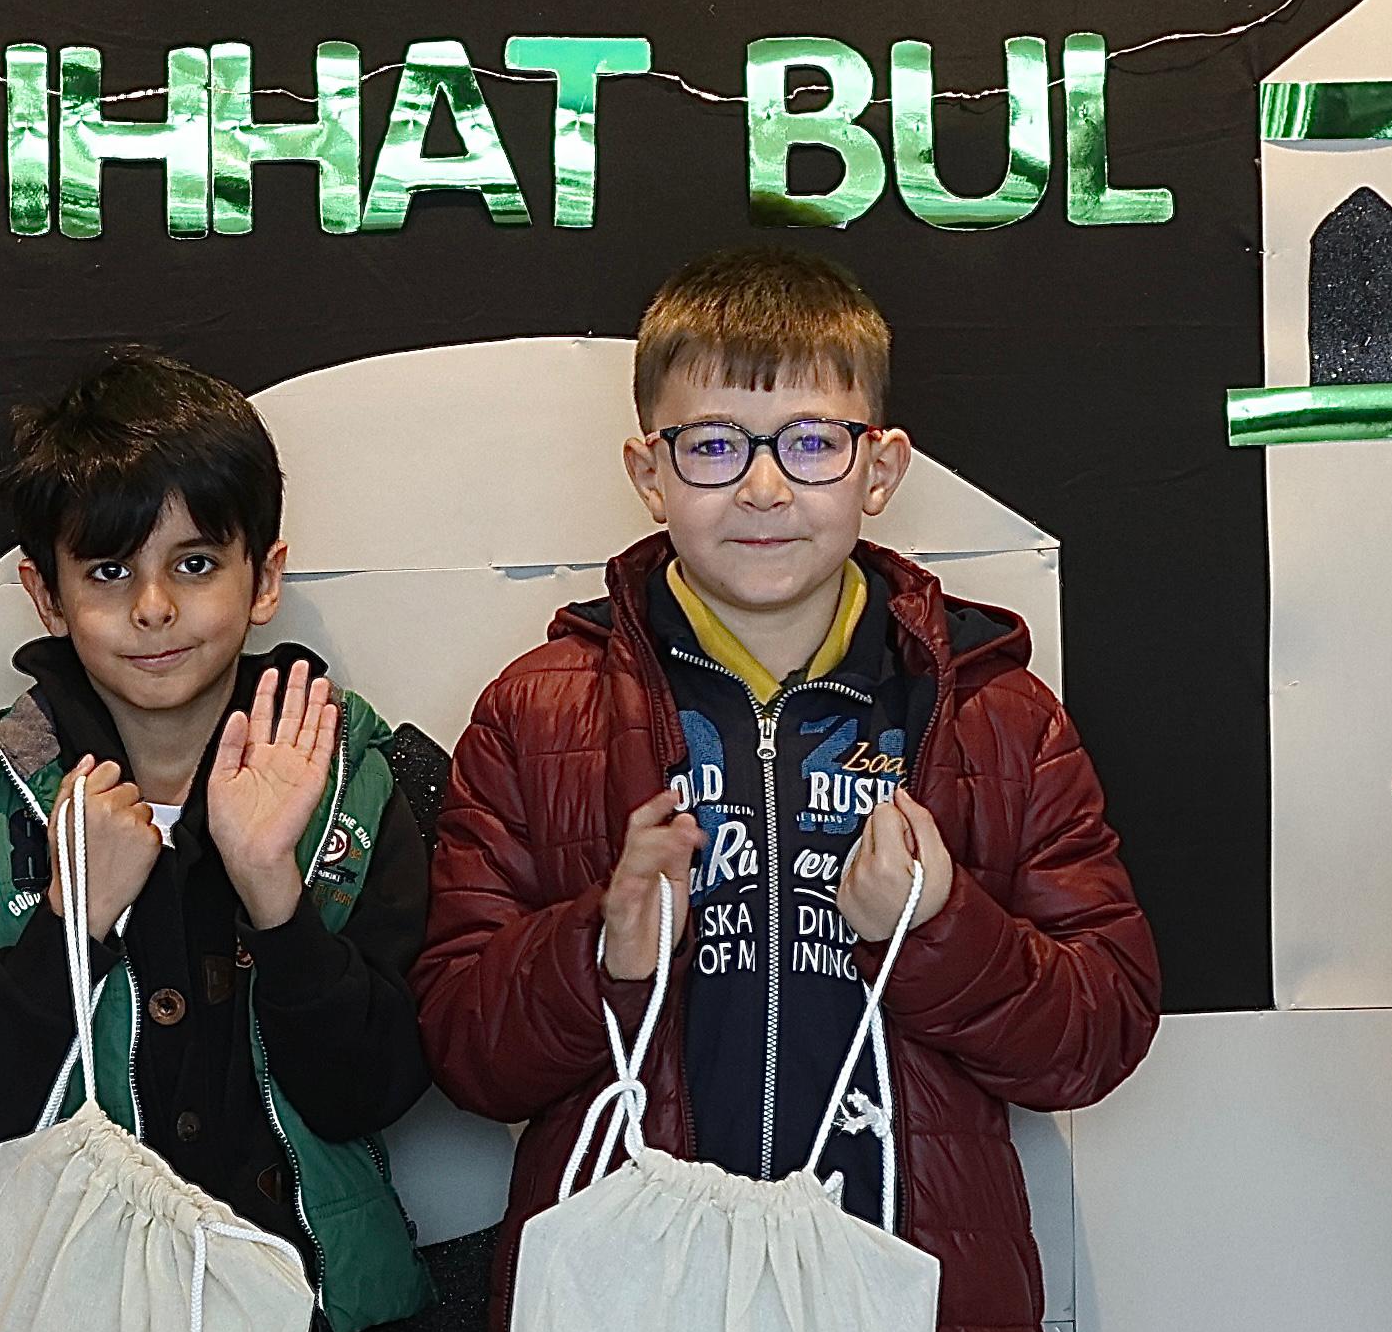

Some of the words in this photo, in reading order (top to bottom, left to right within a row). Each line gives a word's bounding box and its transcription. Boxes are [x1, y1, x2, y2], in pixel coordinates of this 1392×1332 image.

[745, 32, 1175, 232] BUL
[808, 771, 896, 815] RUSH
[355, 826, 372, 849] END
[699, 902, 754, 937] SKA
[699, 944, 732, 975] OF
